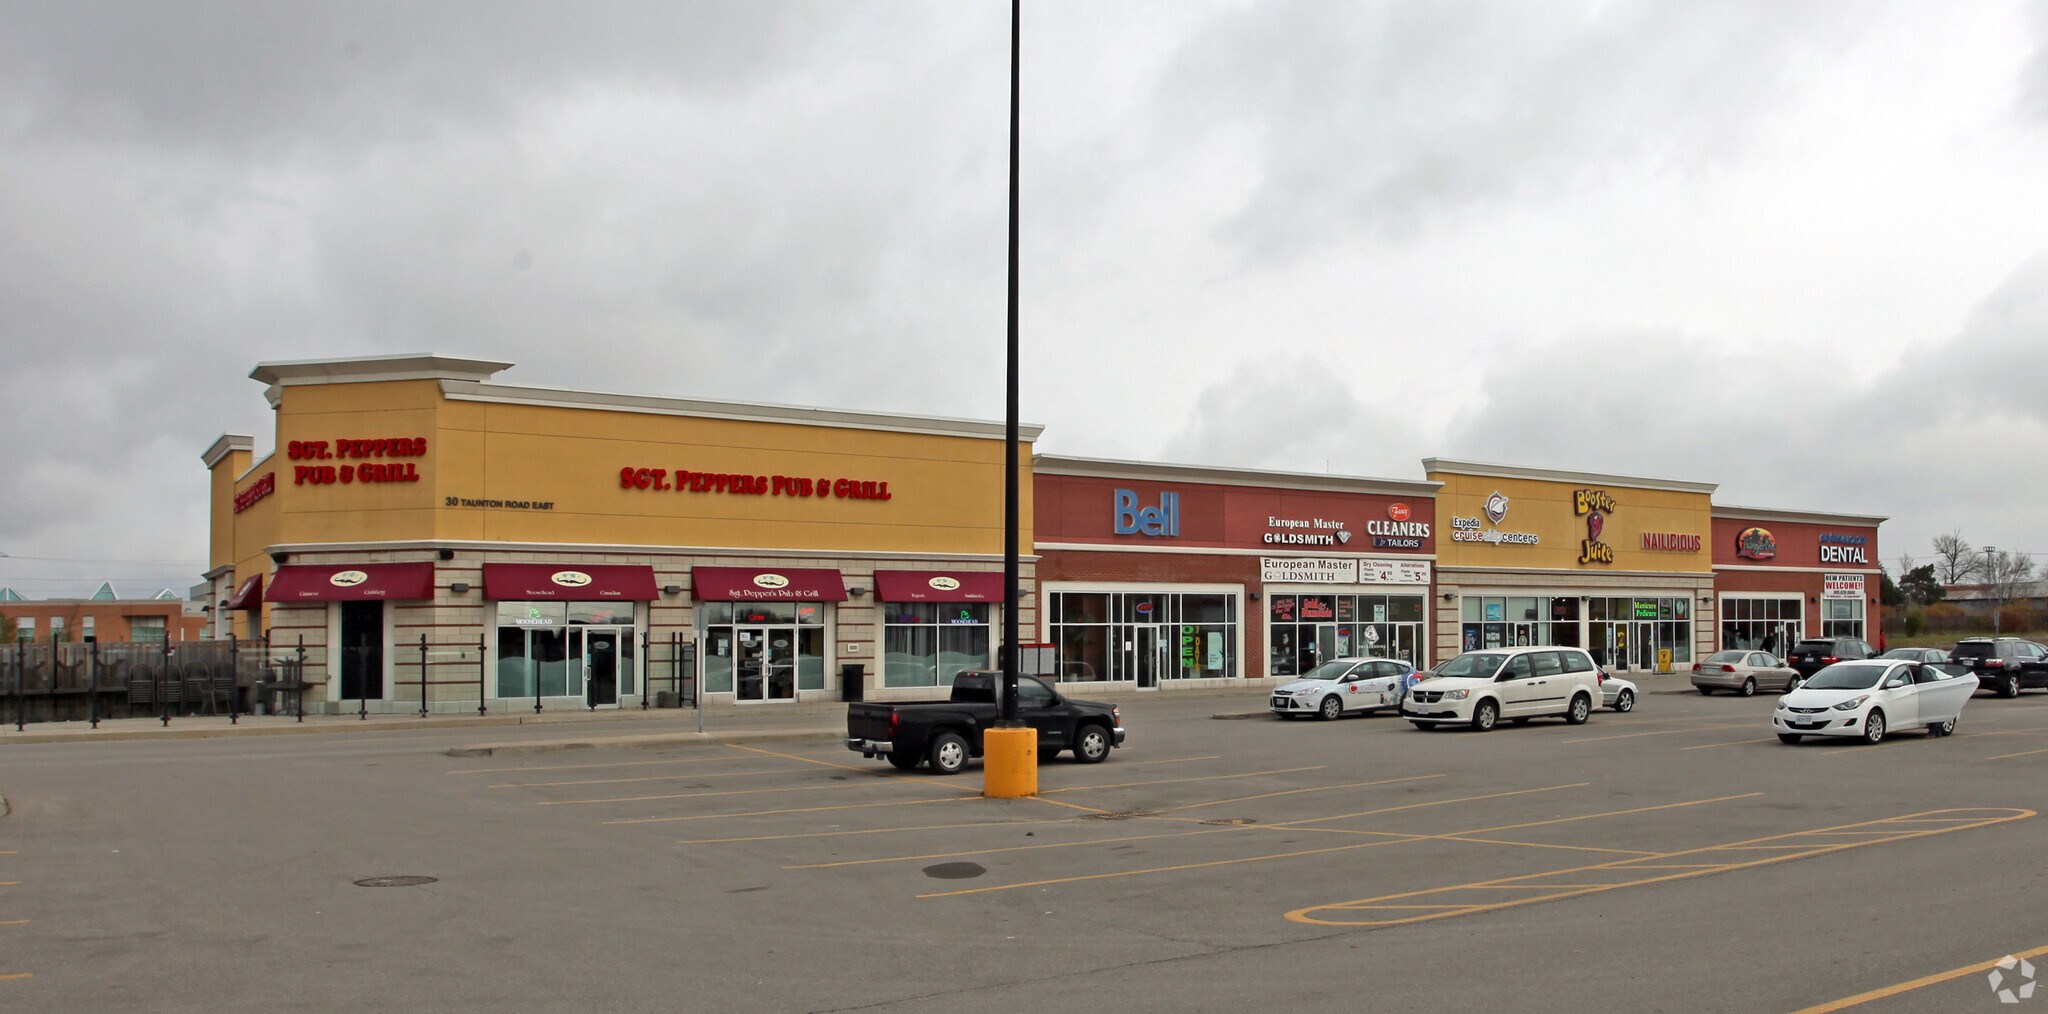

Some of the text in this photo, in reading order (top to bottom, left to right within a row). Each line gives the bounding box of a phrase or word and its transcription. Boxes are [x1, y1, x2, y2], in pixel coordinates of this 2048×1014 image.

[288, 437, 427, 460] SGT. PEPPERS
[294, 463, 420, 485] PUB & GRILL
[620, 467, 892, 500] SGT. PEPPERS PUB & GRILL
[445, 497, 555, 510] 30 TAUNTON ROAD EAST
[1576, 489, 1617, 515] Booster
[1114, 488, 1179, 536] Bell
[1268, 516, 1344, 530] European Master
[1367, 520, 1430, 538] CLEANERS
[1454, 517, 1480, 529] Expedia
[1387, 538, 1419, 547] TAILORS
[1642, 532, 1700, 551] NAILICIOUS
[1581, 540, 1613, 564] Juice
[1821, 545, 1868, 563] DENTAL
[1264, 559, 1352, 570] European Master
[1825, 582, 1863, 590] WELCOME!!
[1634, 602, 1657, 610] Manicure
[1182, 625, 1194, 668] OPEN
